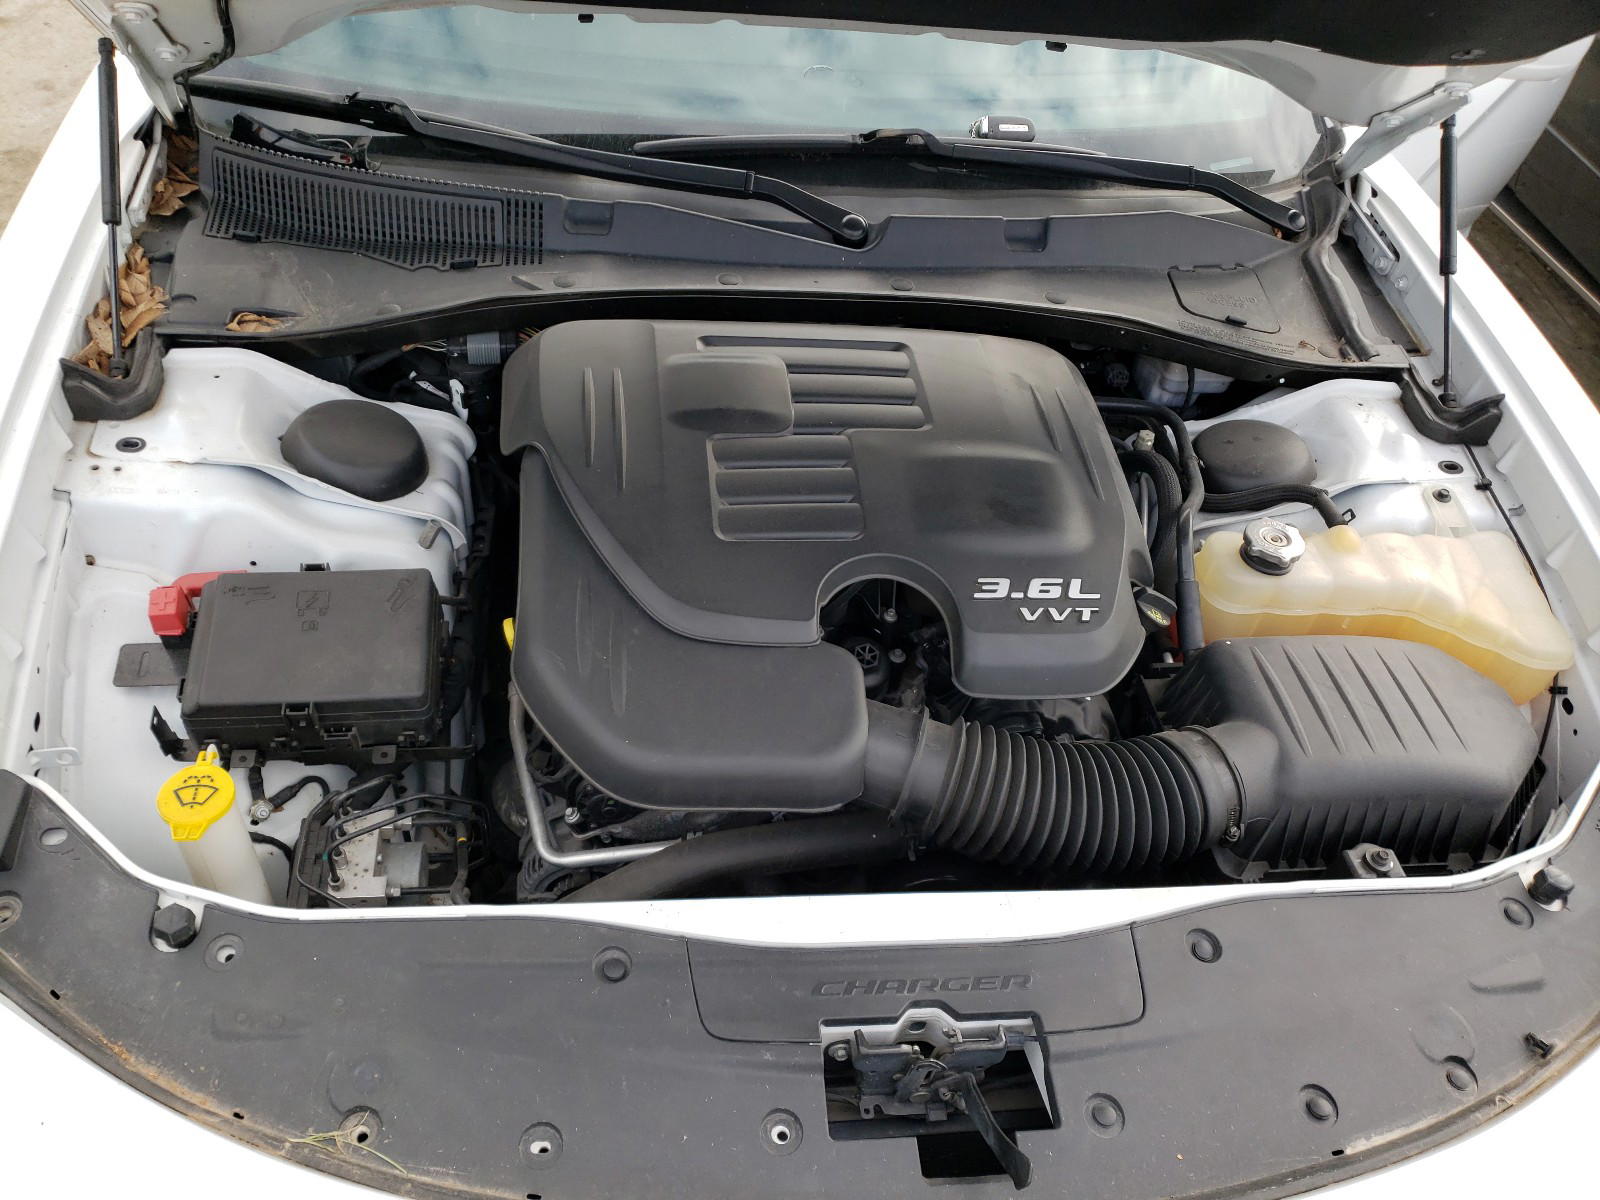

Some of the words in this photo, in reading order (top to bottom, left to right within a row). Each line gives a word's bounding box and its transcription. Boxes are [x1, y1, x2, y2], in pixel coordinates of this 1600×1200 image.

[973, 576, 1102, 598] 3.6L
[1020, 606, 1099, 621] VVT
[811, 974, 1034, 996] CHARGER
